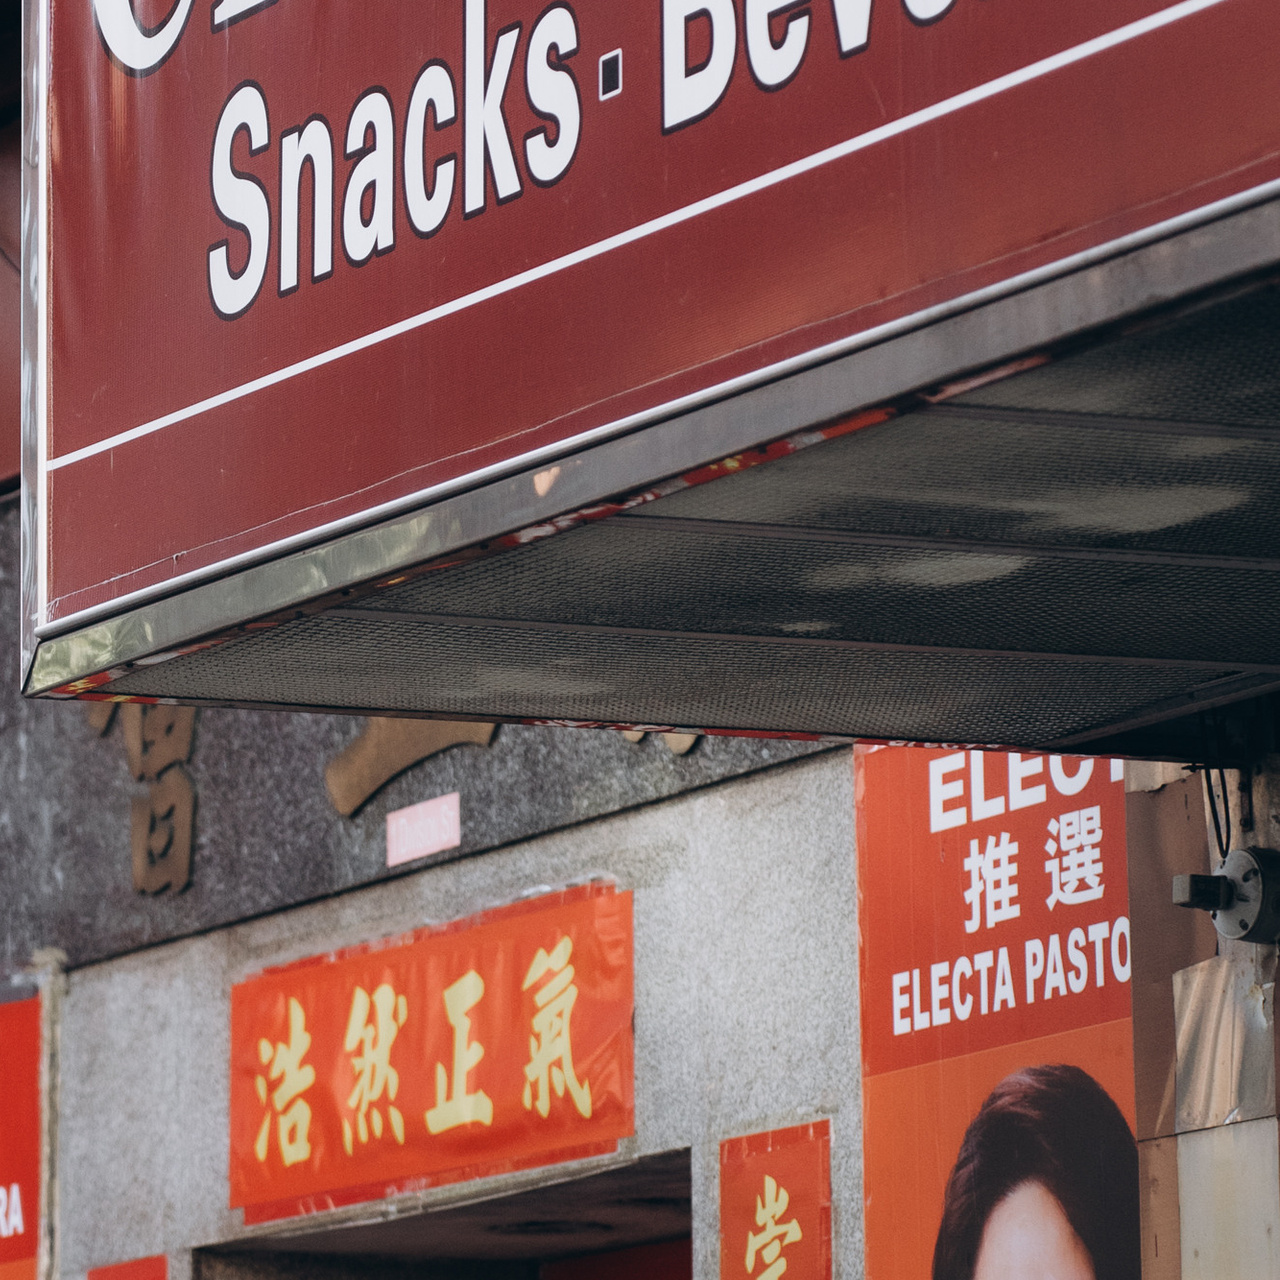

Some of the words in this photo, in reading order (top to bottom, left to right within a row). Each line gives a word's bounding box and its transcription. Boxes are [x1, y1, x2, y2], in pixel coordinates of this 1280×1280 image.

[929, 750, 1124, 834] ELEC
[964, 805, 1106, 934] 推選
[892, 946, 1016, 1036] ELECTA
[1024, 915, 1132, 1005] PASTO
